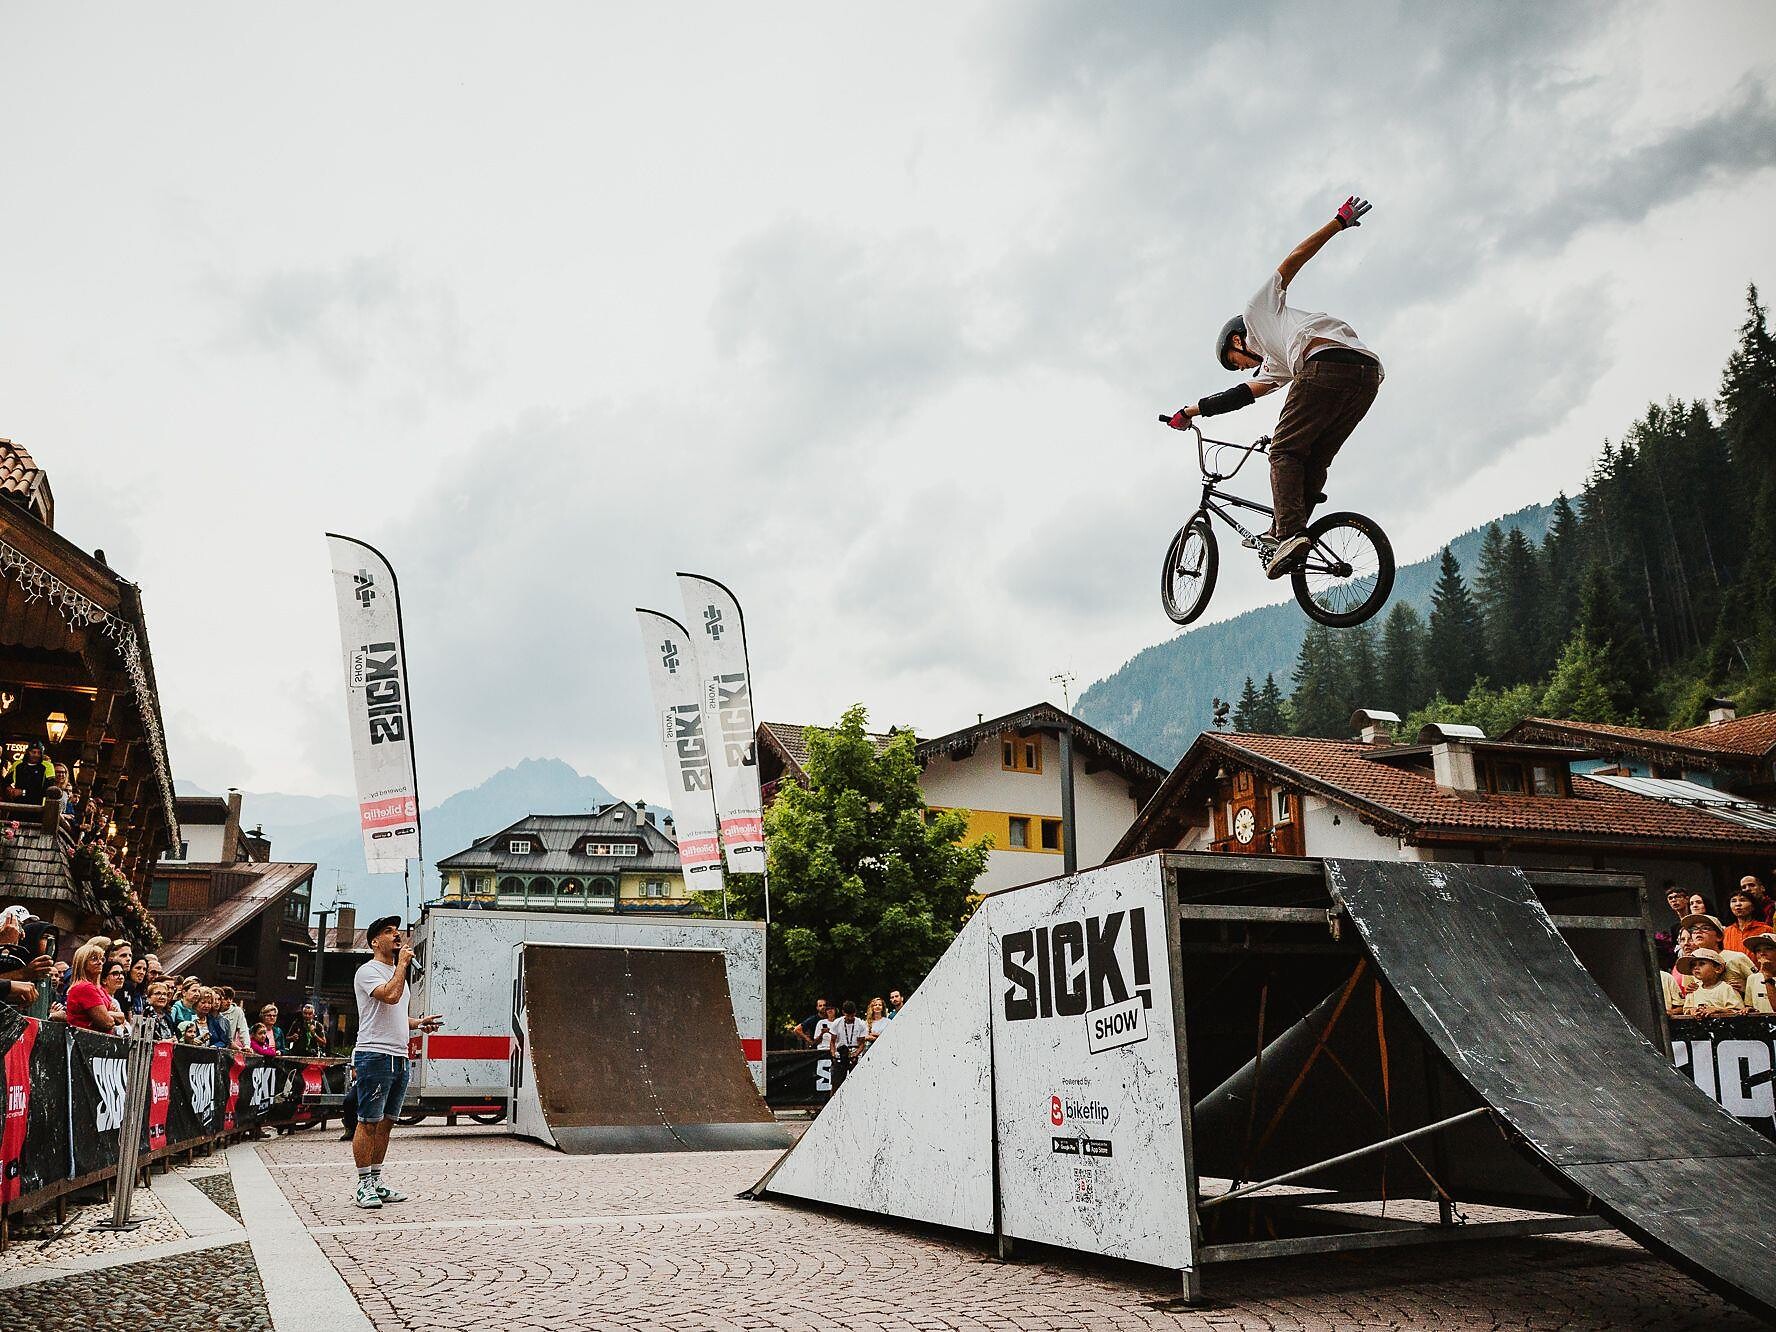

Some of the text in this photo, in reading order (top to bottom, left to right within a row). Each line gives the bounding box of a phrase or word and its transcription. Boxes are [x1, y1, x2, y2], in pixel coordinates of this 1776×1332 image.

[1002, 907, 1152, 1021] SICK!
[1095, 1008, 1138, 1039] SHOW
[1062, 1077, 1083, 1086] Powered
[1066, 1101, 1109, 1125] bikeflip
